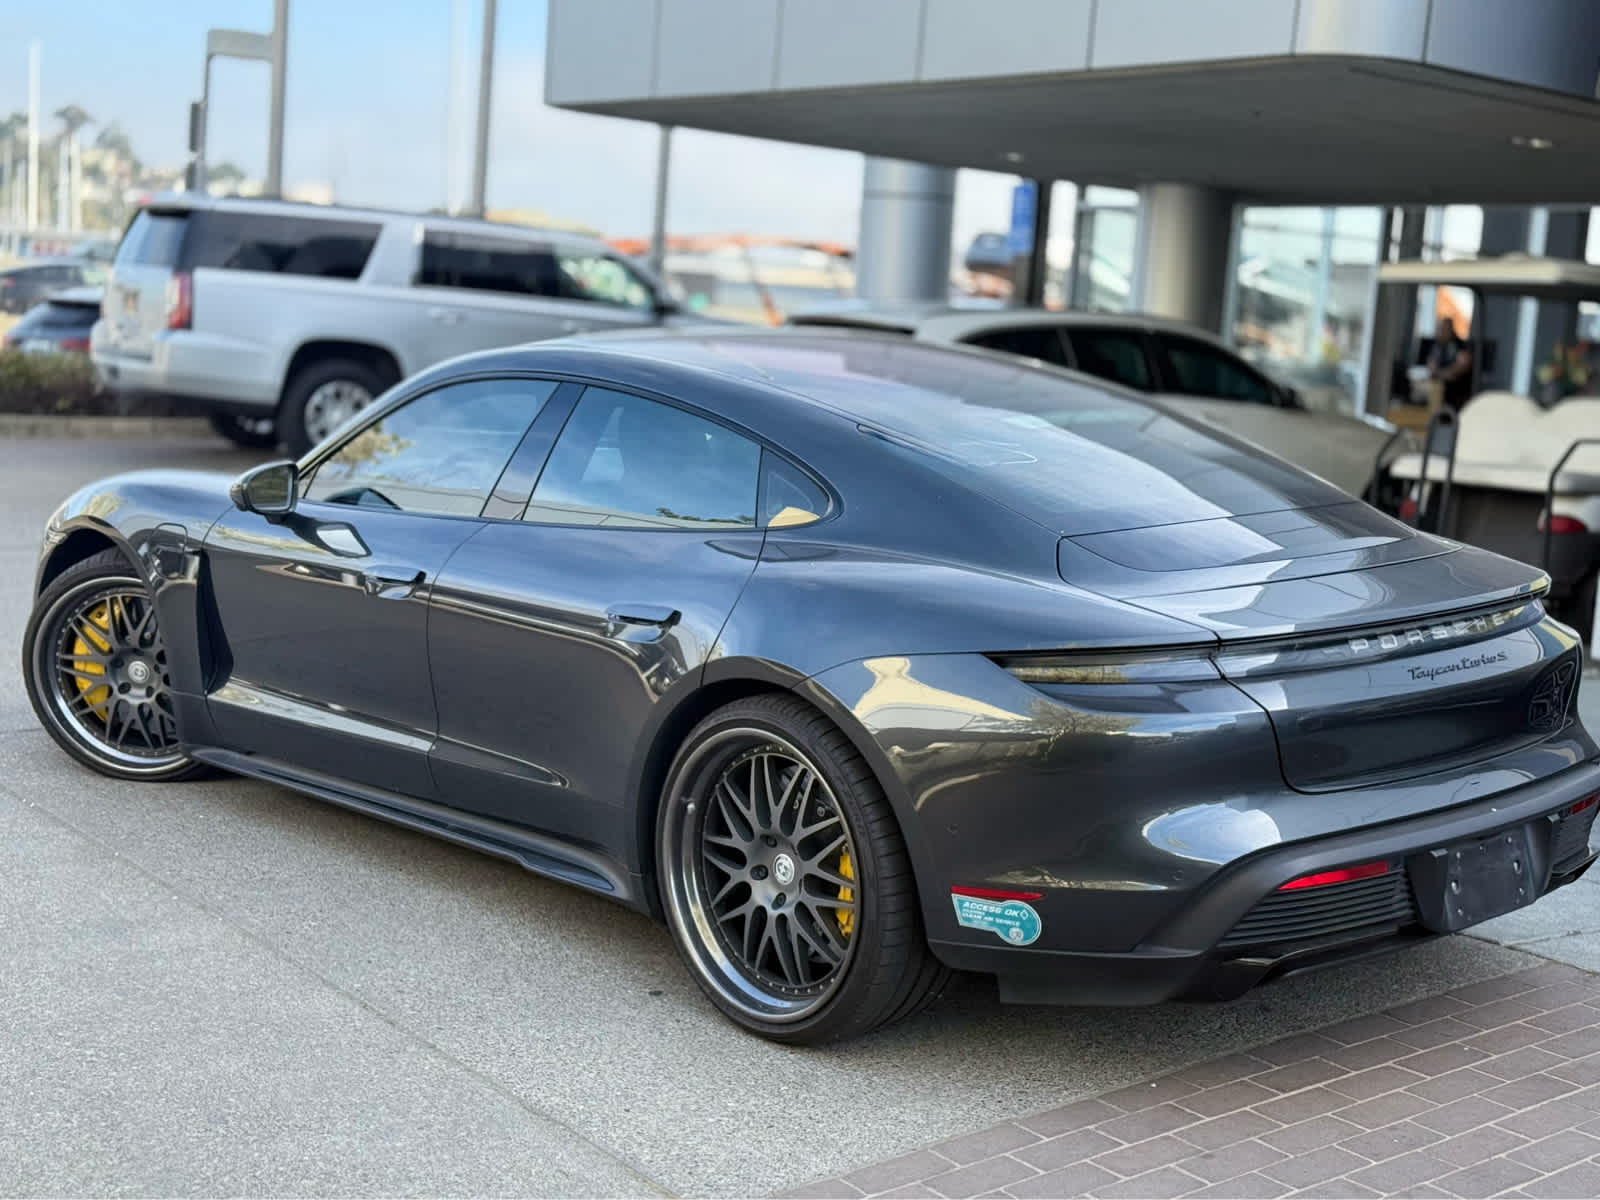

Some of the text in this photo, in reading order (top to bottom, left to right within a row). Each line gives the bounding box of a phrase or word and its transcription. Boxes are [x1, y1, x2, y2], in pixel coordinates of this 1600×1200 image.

[1348, 613, 1505, 654] PORSCHE
[962, 901, 1002, 914] ACCESS
[1004, 908, 1020, 918] OK
